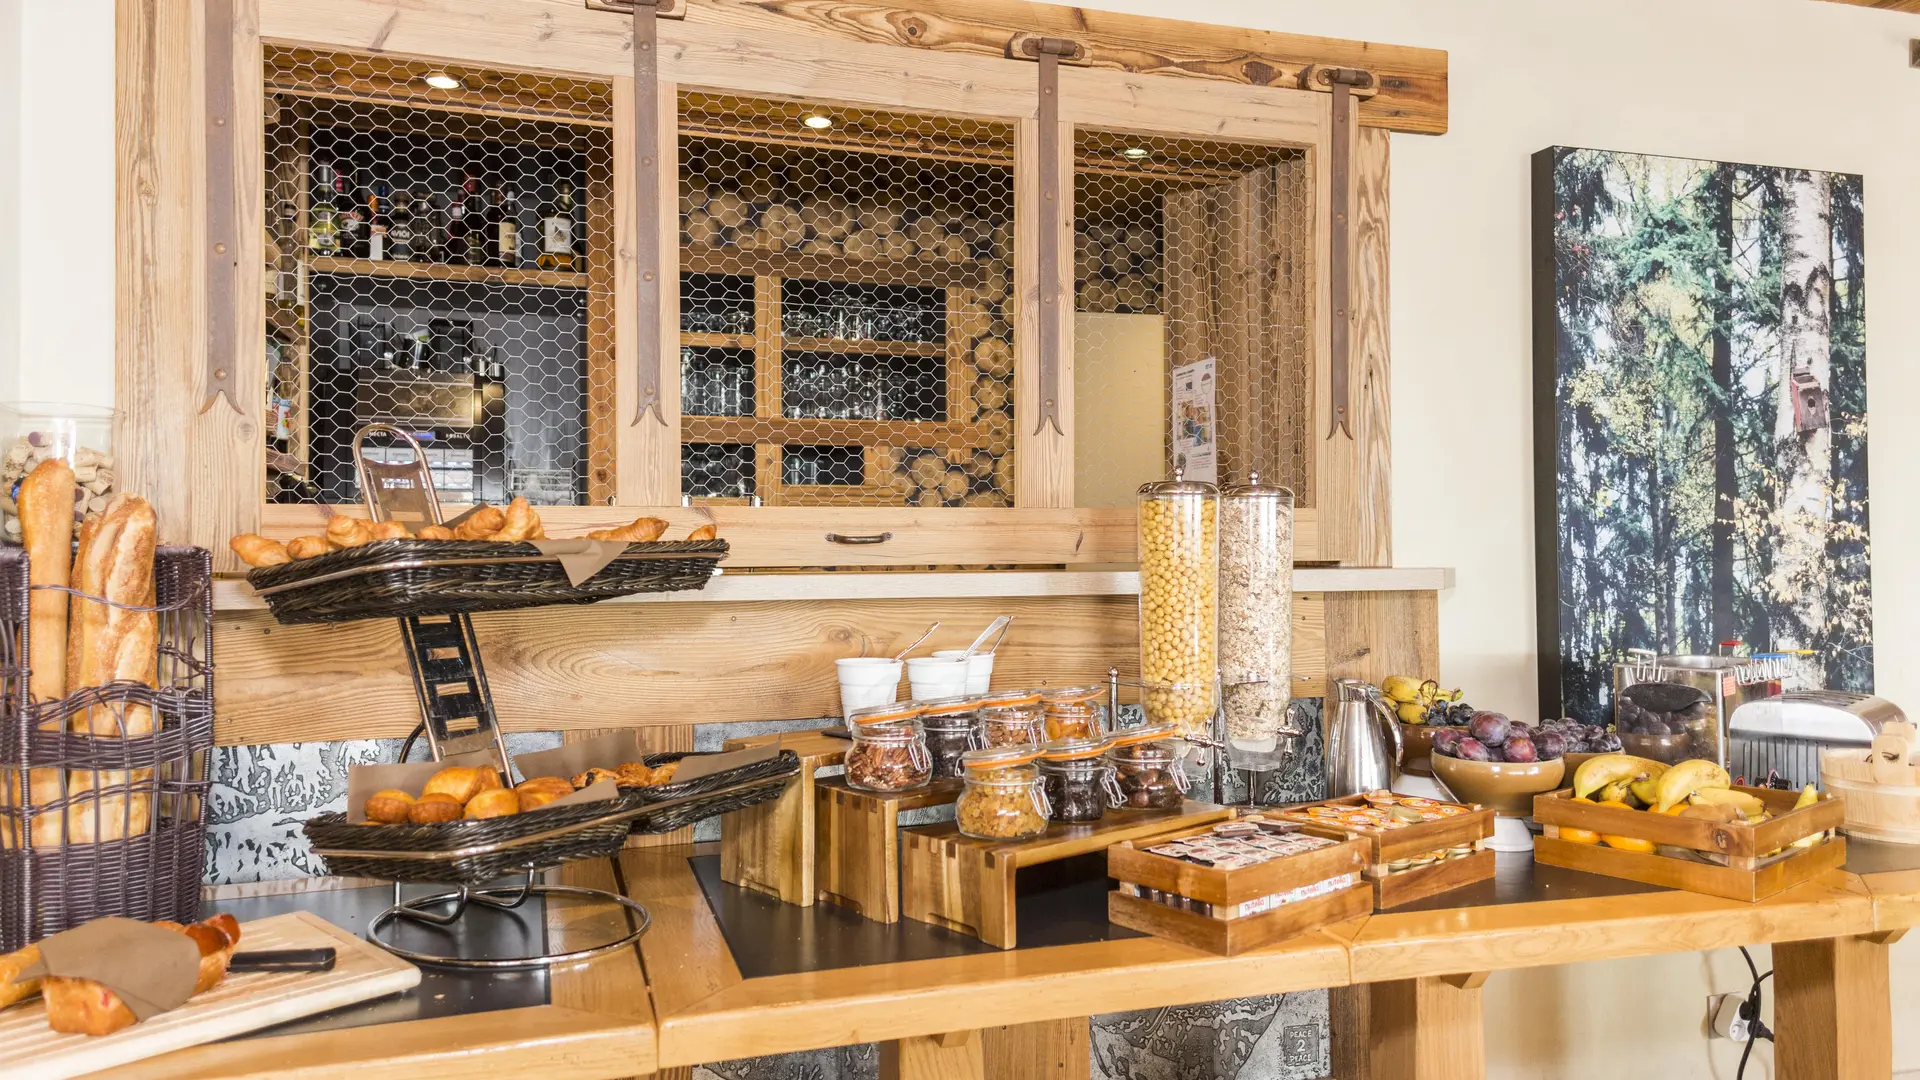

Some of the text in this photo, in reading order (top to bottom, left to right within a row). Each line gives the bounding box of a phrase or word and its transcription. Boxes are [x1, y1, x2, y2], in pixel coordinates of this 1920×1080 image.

[1289, 1030, 1312, 1039] PEACE
[1296, 1039, 1306, 1052] 2
[1289, 1053, 1312, 1062] PEACE
